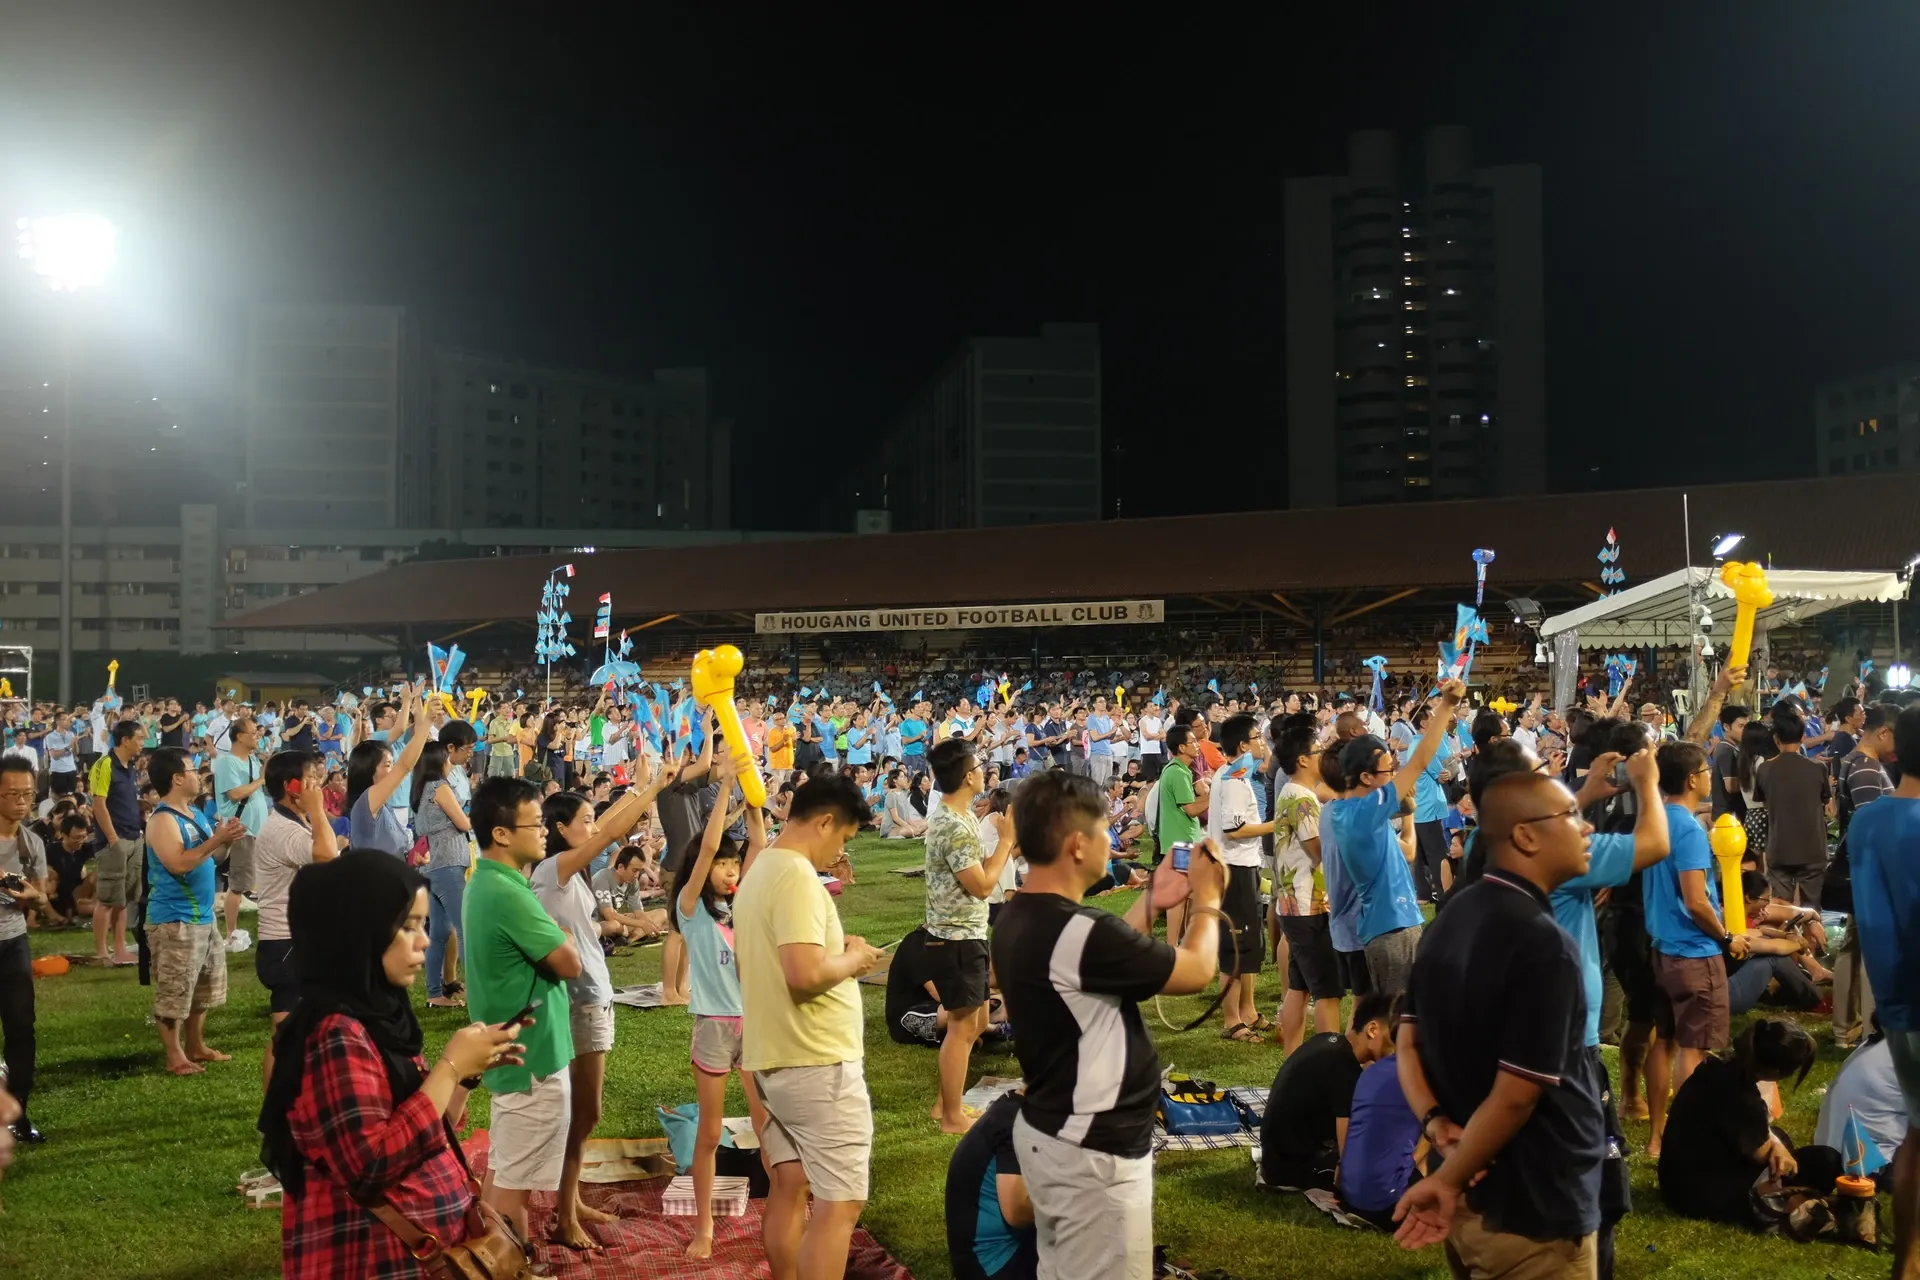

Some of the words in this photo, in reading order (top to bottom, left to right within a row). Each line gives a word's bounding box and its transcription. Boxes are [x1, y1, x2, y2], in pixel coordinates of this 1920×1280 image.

[781, 615, 871, 629] HOUGANG
[879, 612, 948, 627] UNITED
[957, 608, 1063, 625] FOOTBALL
[1071, 606, 1128, 621] CLUB
